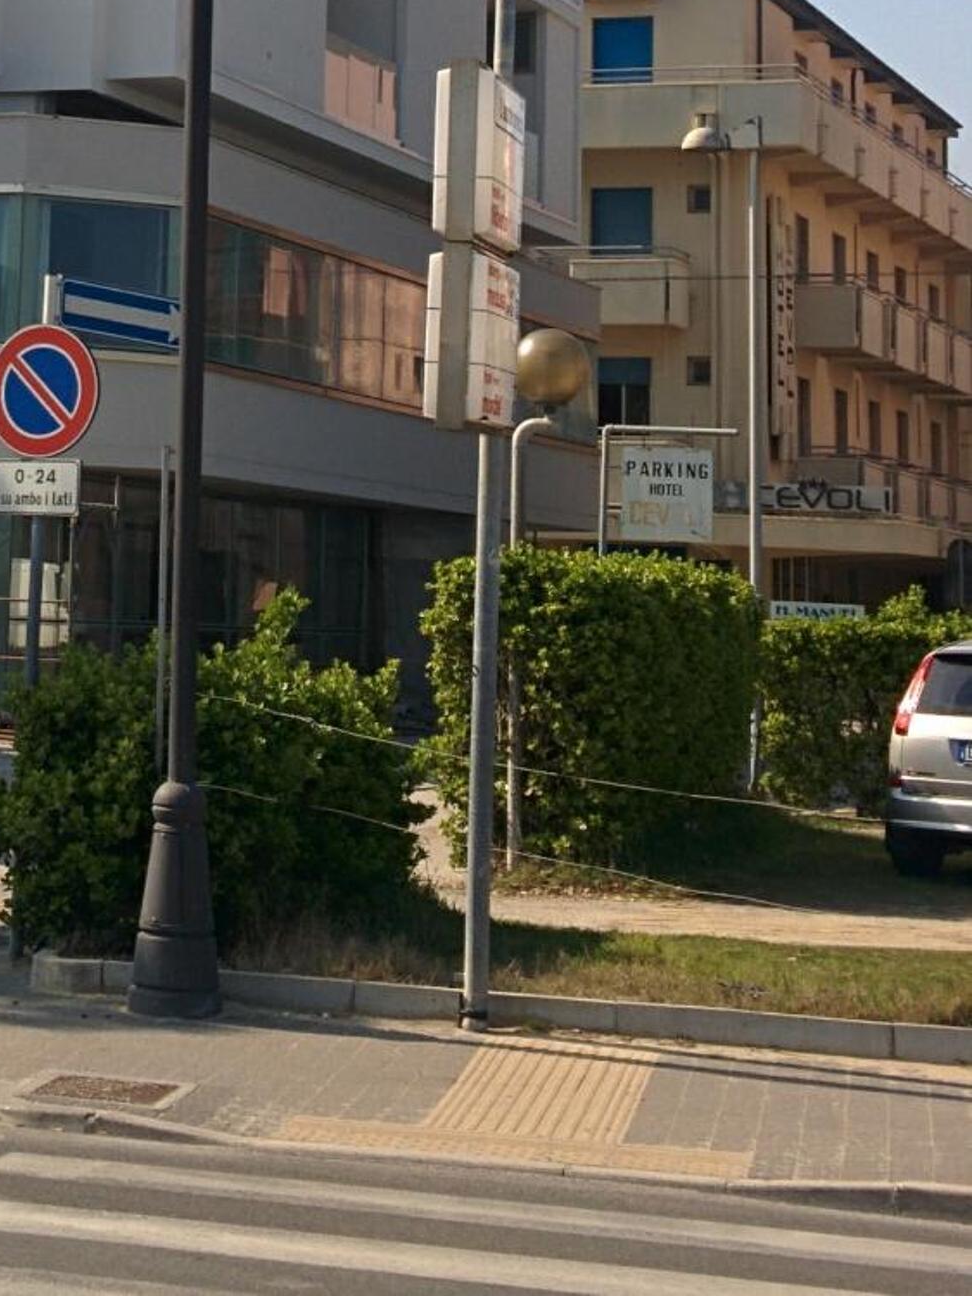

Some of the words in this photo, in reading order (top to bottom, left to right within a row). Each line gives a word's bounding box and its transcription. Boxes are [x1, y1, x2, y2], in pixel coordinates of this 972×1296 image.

[625, 460, 709, 479] PARKING
[649, 483, 684, 497] HOTEL
[14, 492, 42, 506] ambo
[52, 491, 73, 506] lati
